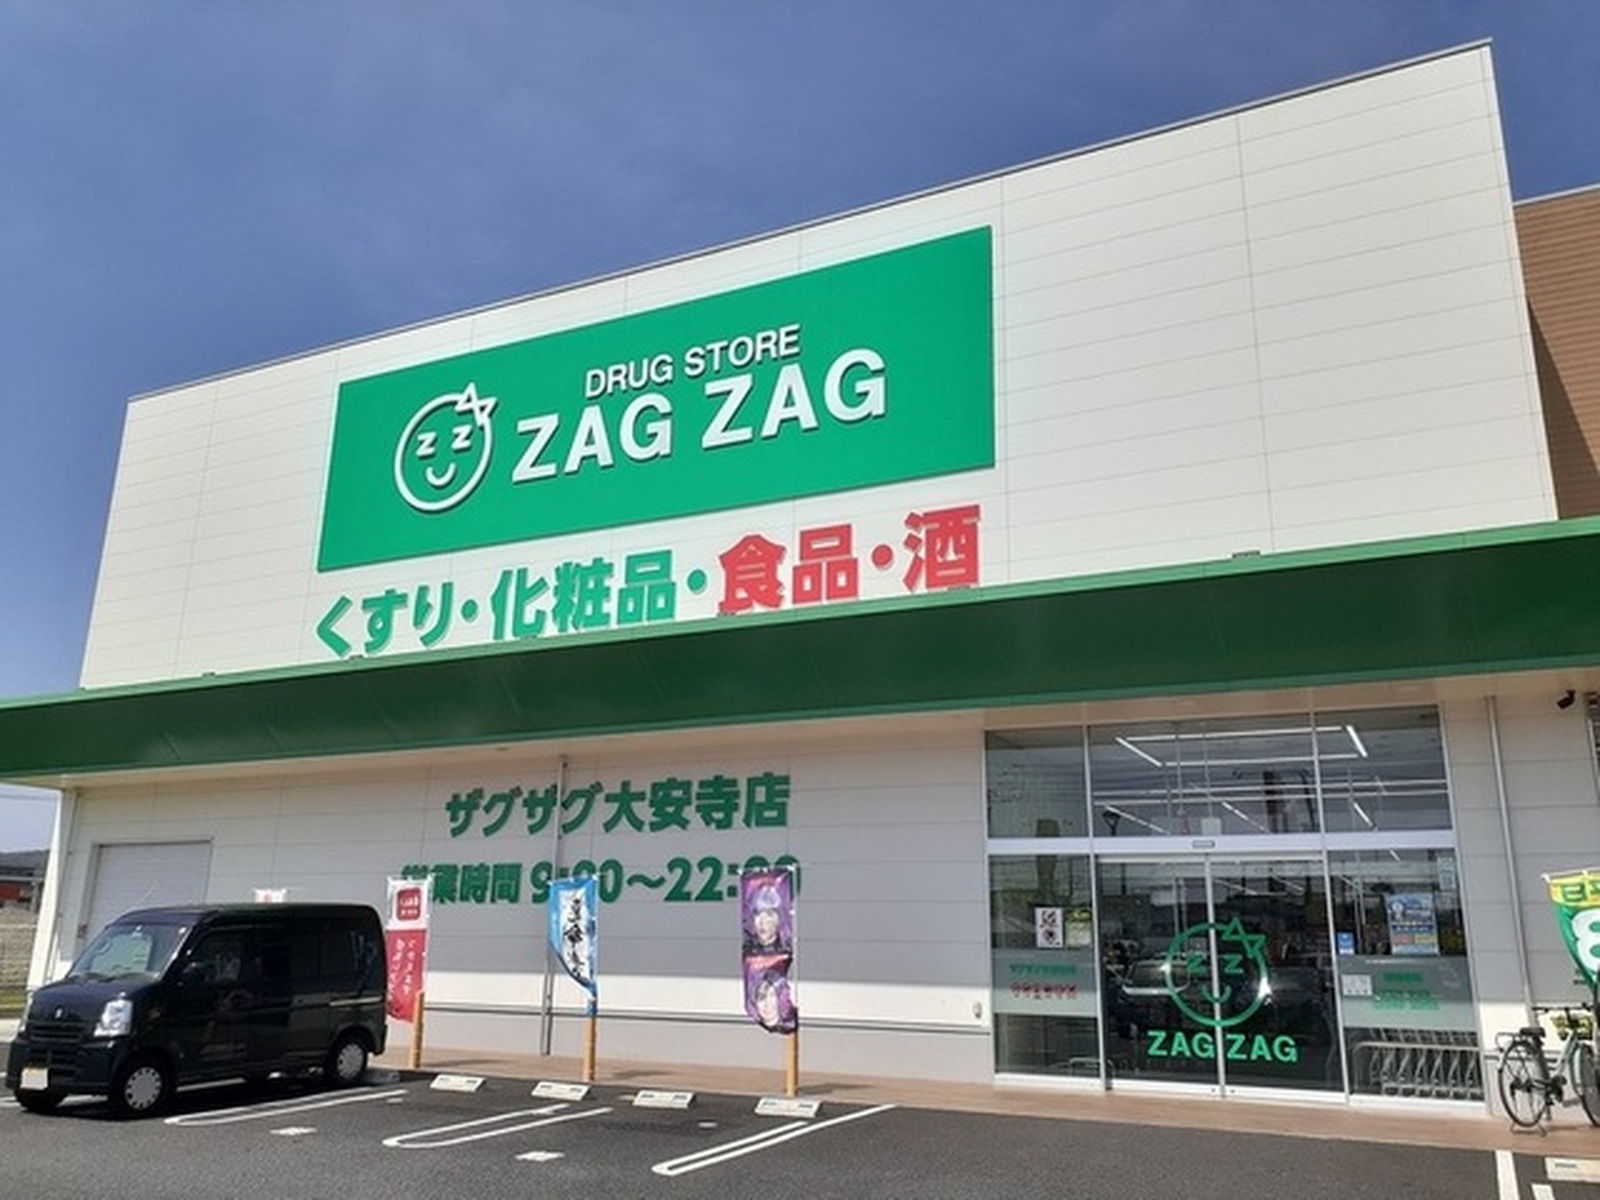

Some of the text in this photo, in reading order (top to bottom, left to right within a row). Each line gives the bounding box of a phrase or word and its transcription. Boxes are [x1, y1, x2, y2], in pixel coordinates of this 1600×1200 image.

[585, 324, 801, 398] DRUG STORE
[512, 348, 886, 483] ZAG ZAG
[446, 772, 792, 838] ザグザグ大安寺店
[1147, 1030, 1298, 1063] ZAG ZAG
